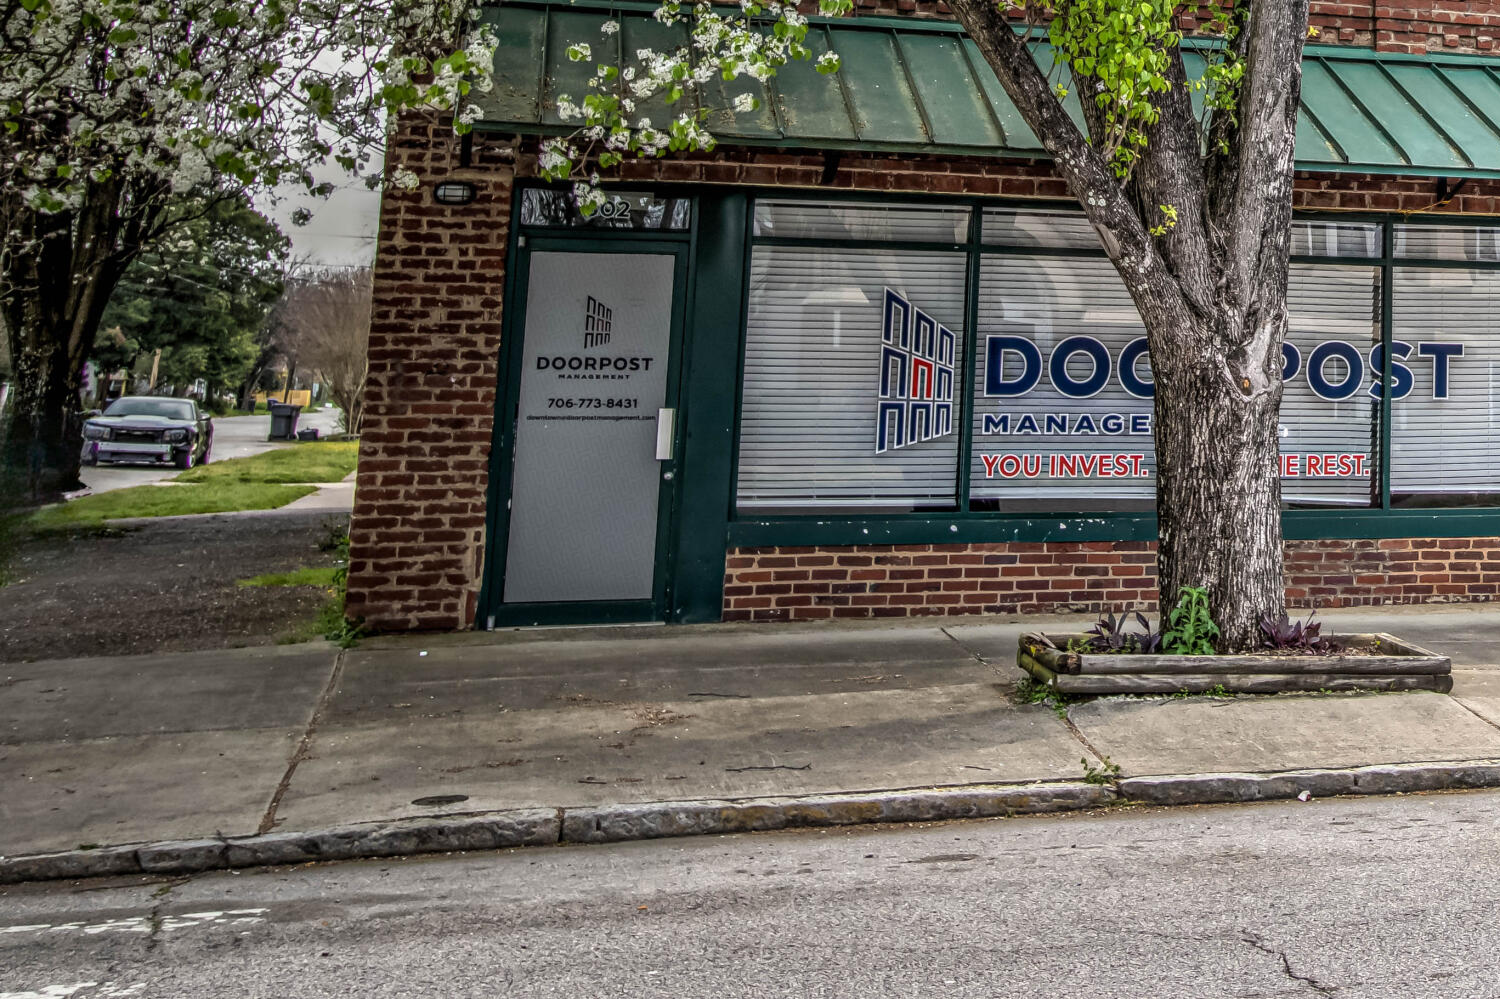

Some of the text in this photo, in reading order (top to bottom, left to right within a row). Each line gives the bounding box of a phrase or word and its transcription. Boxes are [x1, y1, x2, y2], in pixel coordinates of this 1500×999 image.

[584, 200, 631, 220] 02
[536, 356, 654, 371] DOORPOST
[983, 334, 1465, 402] DOOOST
[548, 398, 638, 409] 706-773-8431
[982, 413, 1152, 435] MANAGE
[981, 454, 1149, 478] YOU INVEST.
[1305, 453, 1371, 477] REST.
